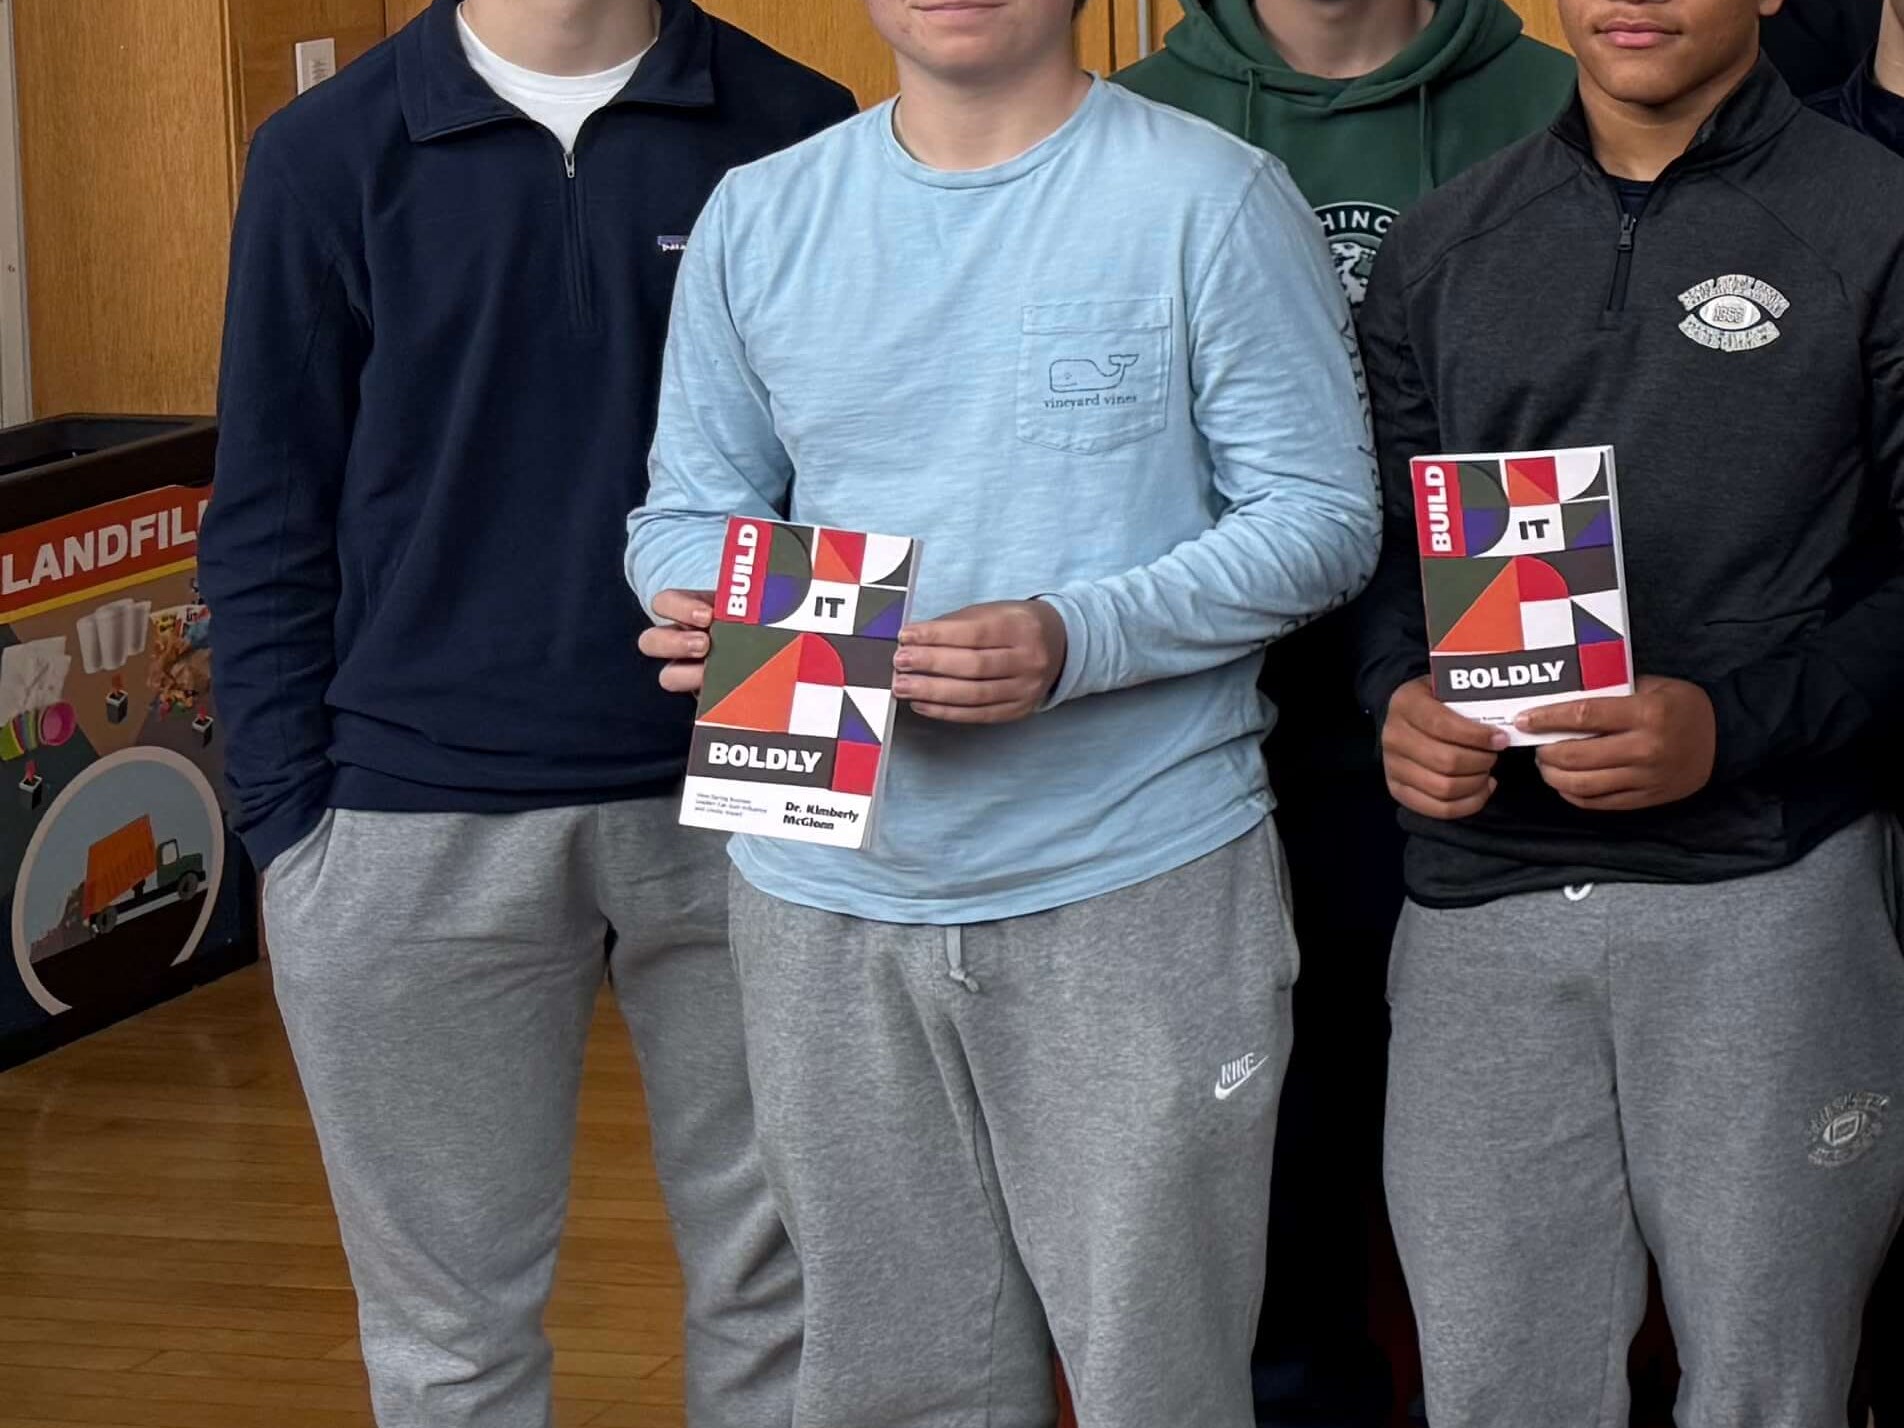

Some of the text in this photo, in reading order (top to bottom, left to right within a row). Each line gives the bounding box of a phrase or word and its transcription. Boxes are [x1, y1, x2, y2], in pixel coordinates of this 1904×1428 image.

[1043, 394, 1137, 410] vineyard vines
[1425, 465, 1452, 552] BUILD
[1519, 518, 1549, 540] IT
[727, 524, 757, 617] BUILD
[814, 595, 845, 618] IT
[1449, 660, 1564, 690] BOLDLY
[708, 742, 822, 773] BOLDLY
[785, 801, 802, 814] Dr.
[806, 804, 859, 822] Kimberly
[1221, 1052, 1255, 1085] NIKE
